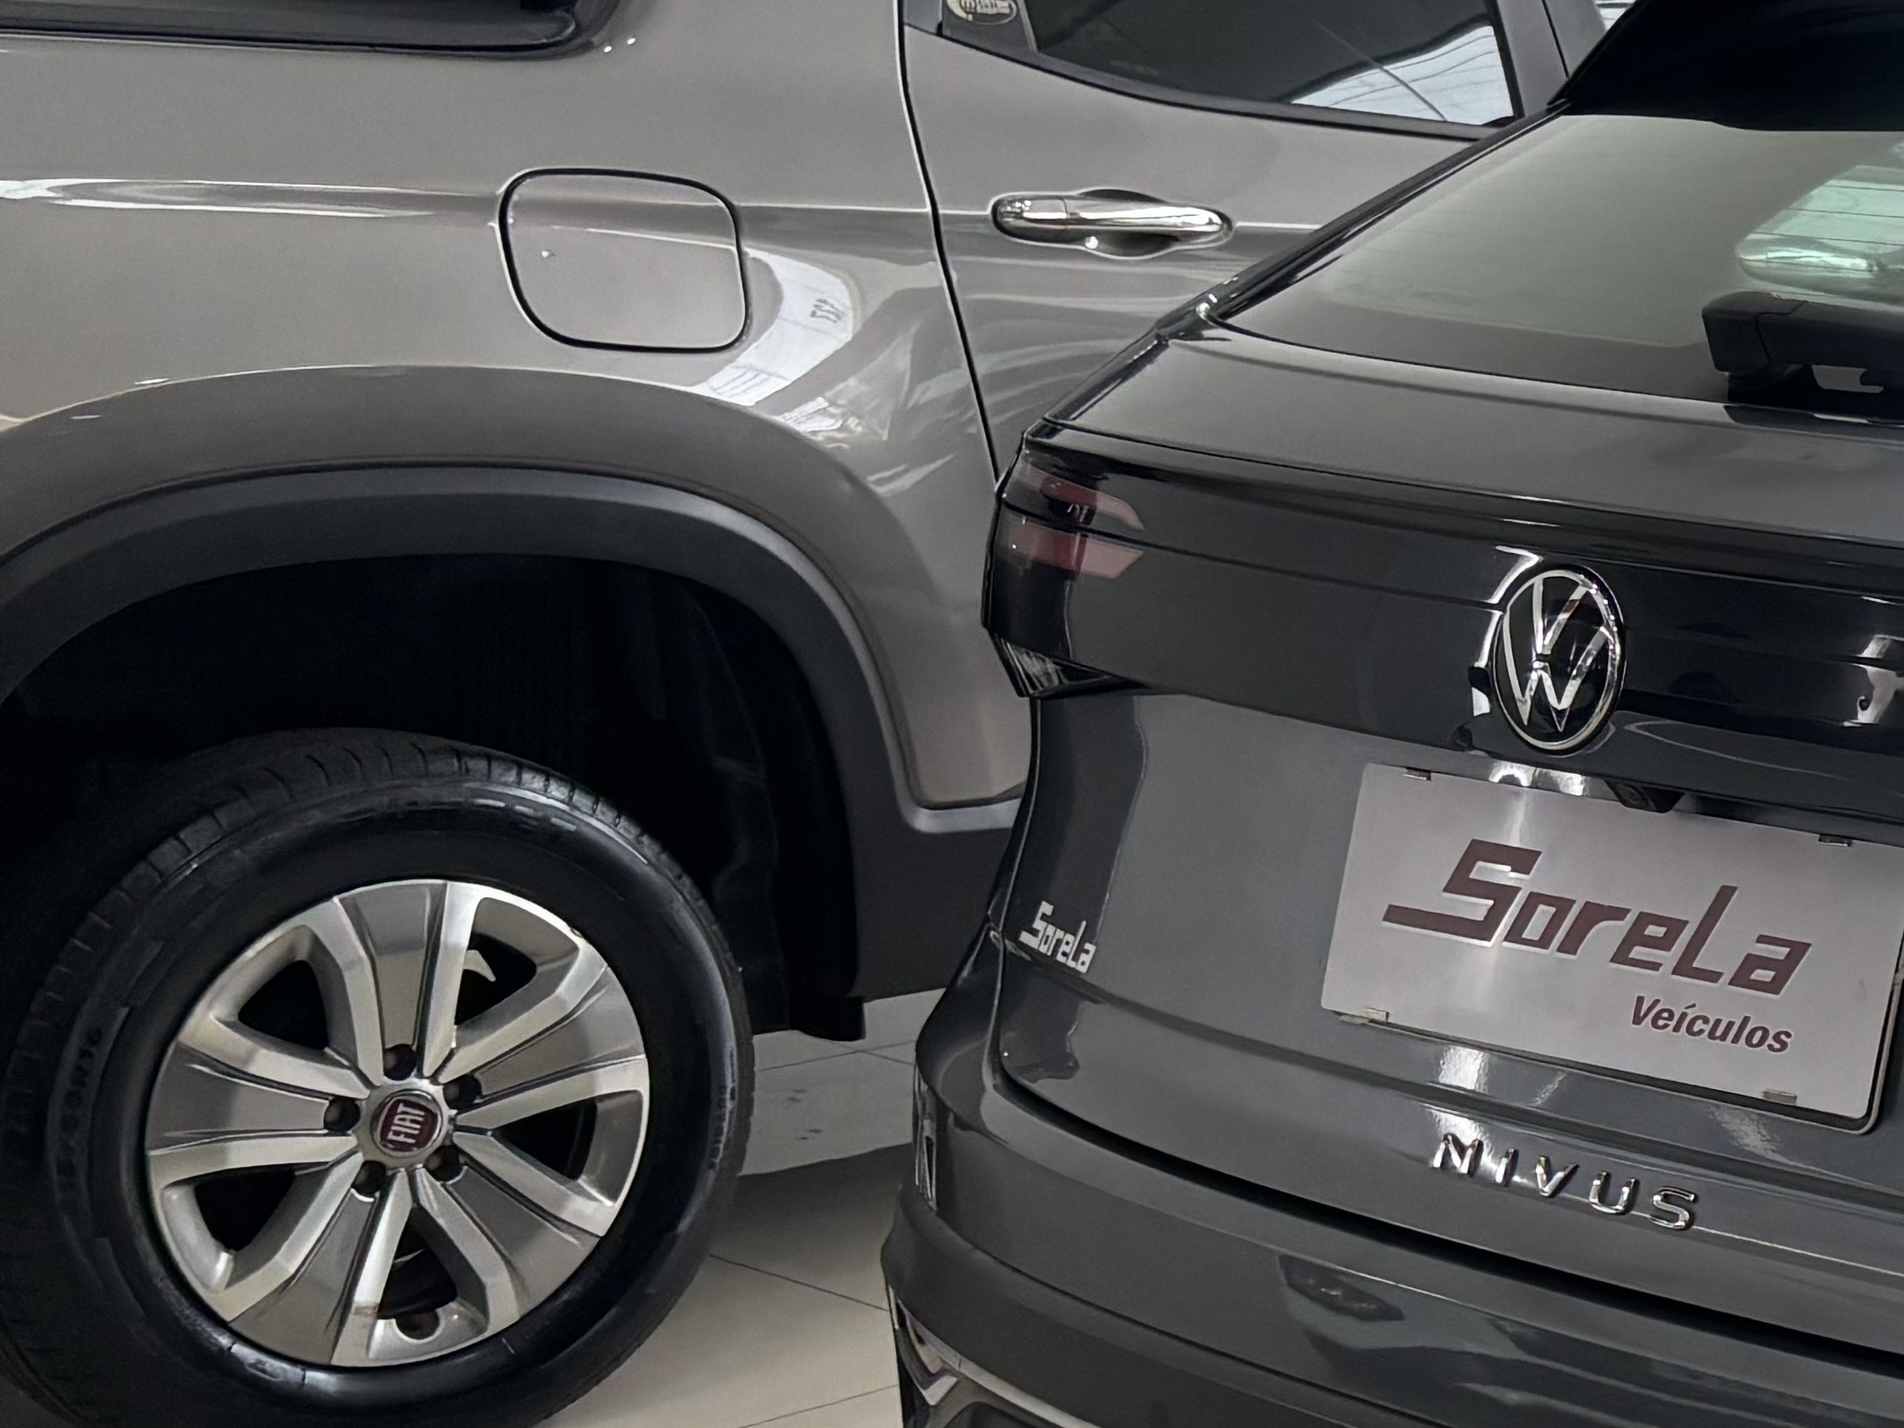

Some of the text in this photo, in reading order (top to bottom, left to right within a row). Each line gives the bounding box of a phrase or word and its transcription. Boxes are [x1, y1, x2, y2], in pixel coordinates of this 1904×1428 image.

[1631, 995, 1794, 1055] Veículos
[386, 1102, 426, 1144] FIAT
[1431, 1132, 1698, 1231] NIVUS
